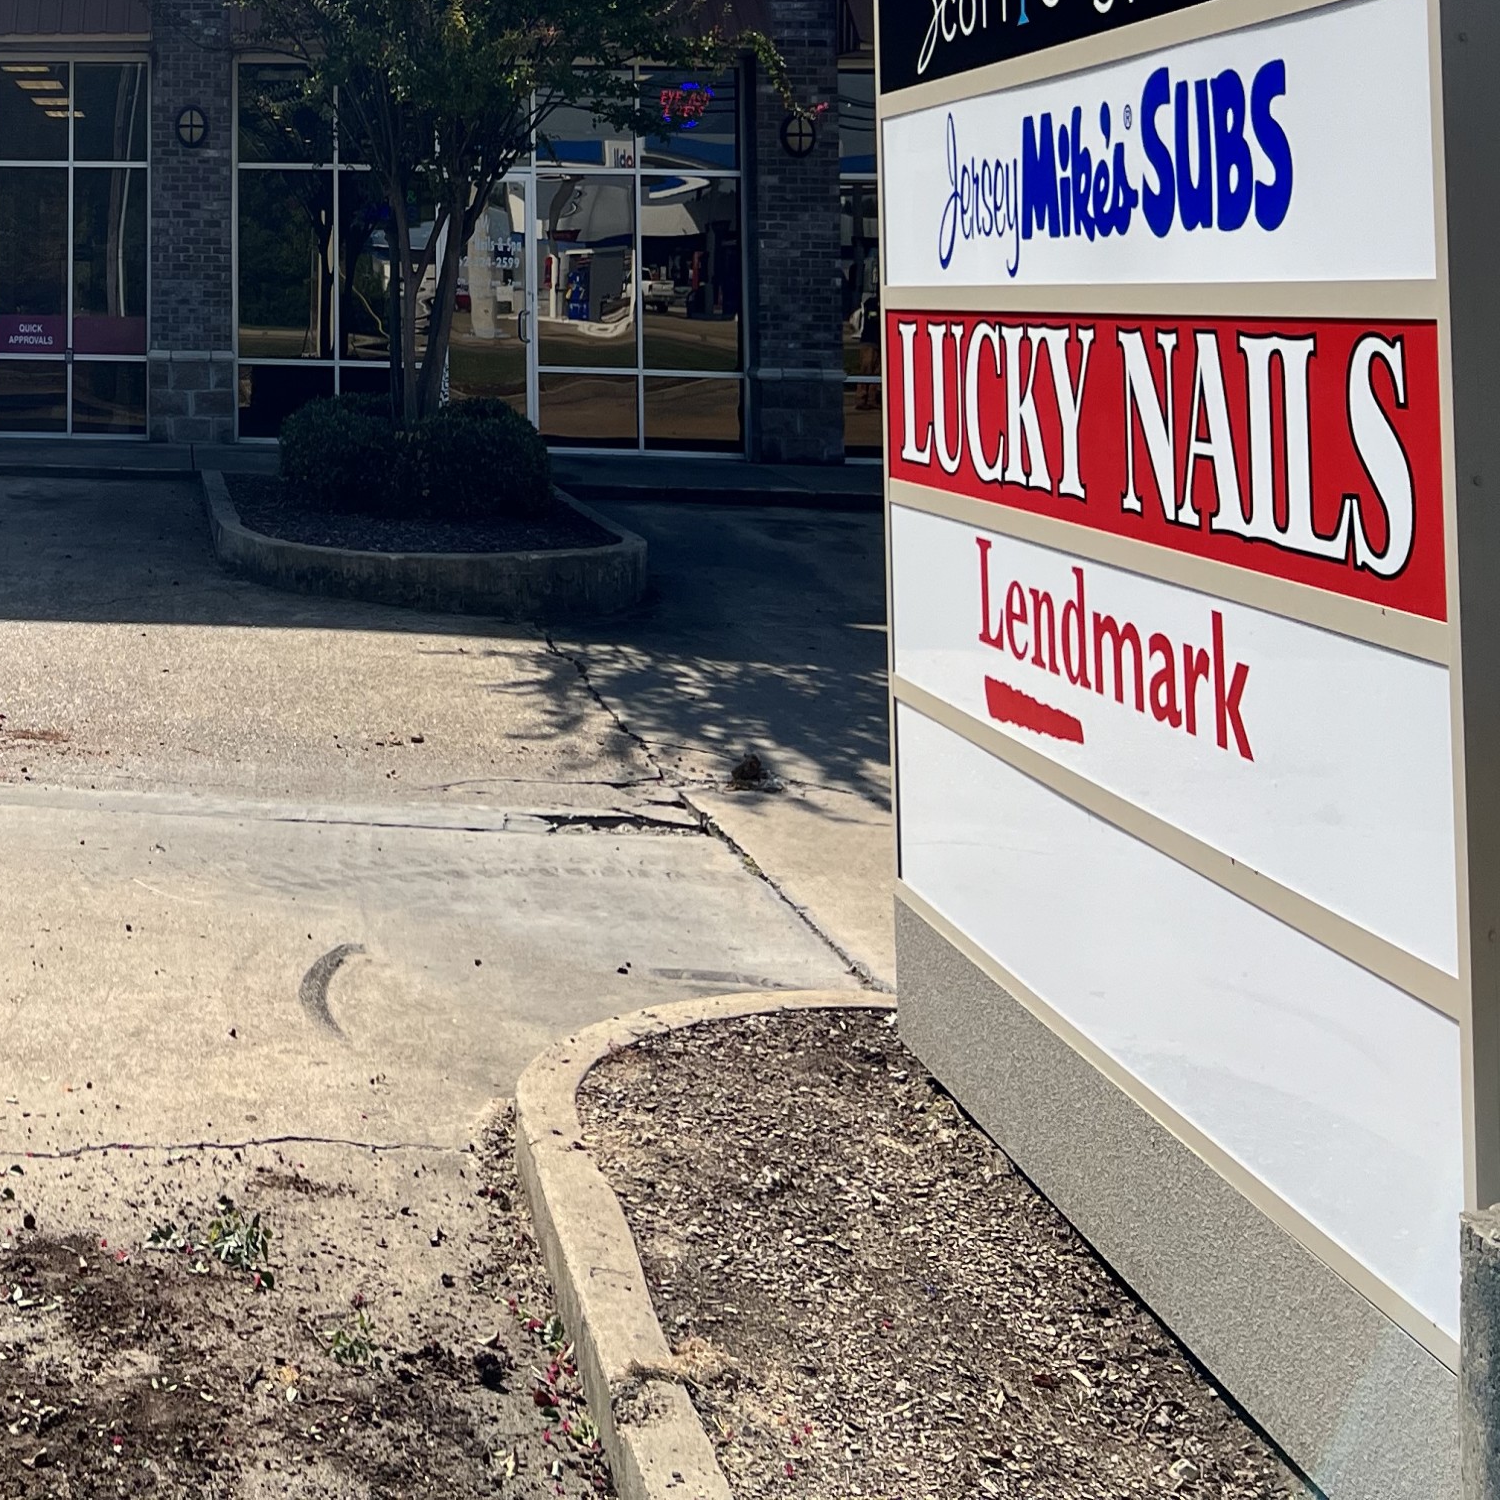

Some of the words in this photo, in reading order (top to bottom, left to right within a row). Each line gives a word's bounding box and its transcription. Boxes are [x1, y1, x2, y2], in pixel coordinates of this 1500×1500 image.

[939, 111, 1020, 278] Jersey
[1141, 59, 1293, 239] SUBS
[8, 335, 54, 346] APPROVALS
[18, 323, 43, 333] QUICK
[897, 321, 1096, 500] LUCKY
[1116, 333, 1415, 579] NAILS
[975, 536, 1255, 763] Lendmark
